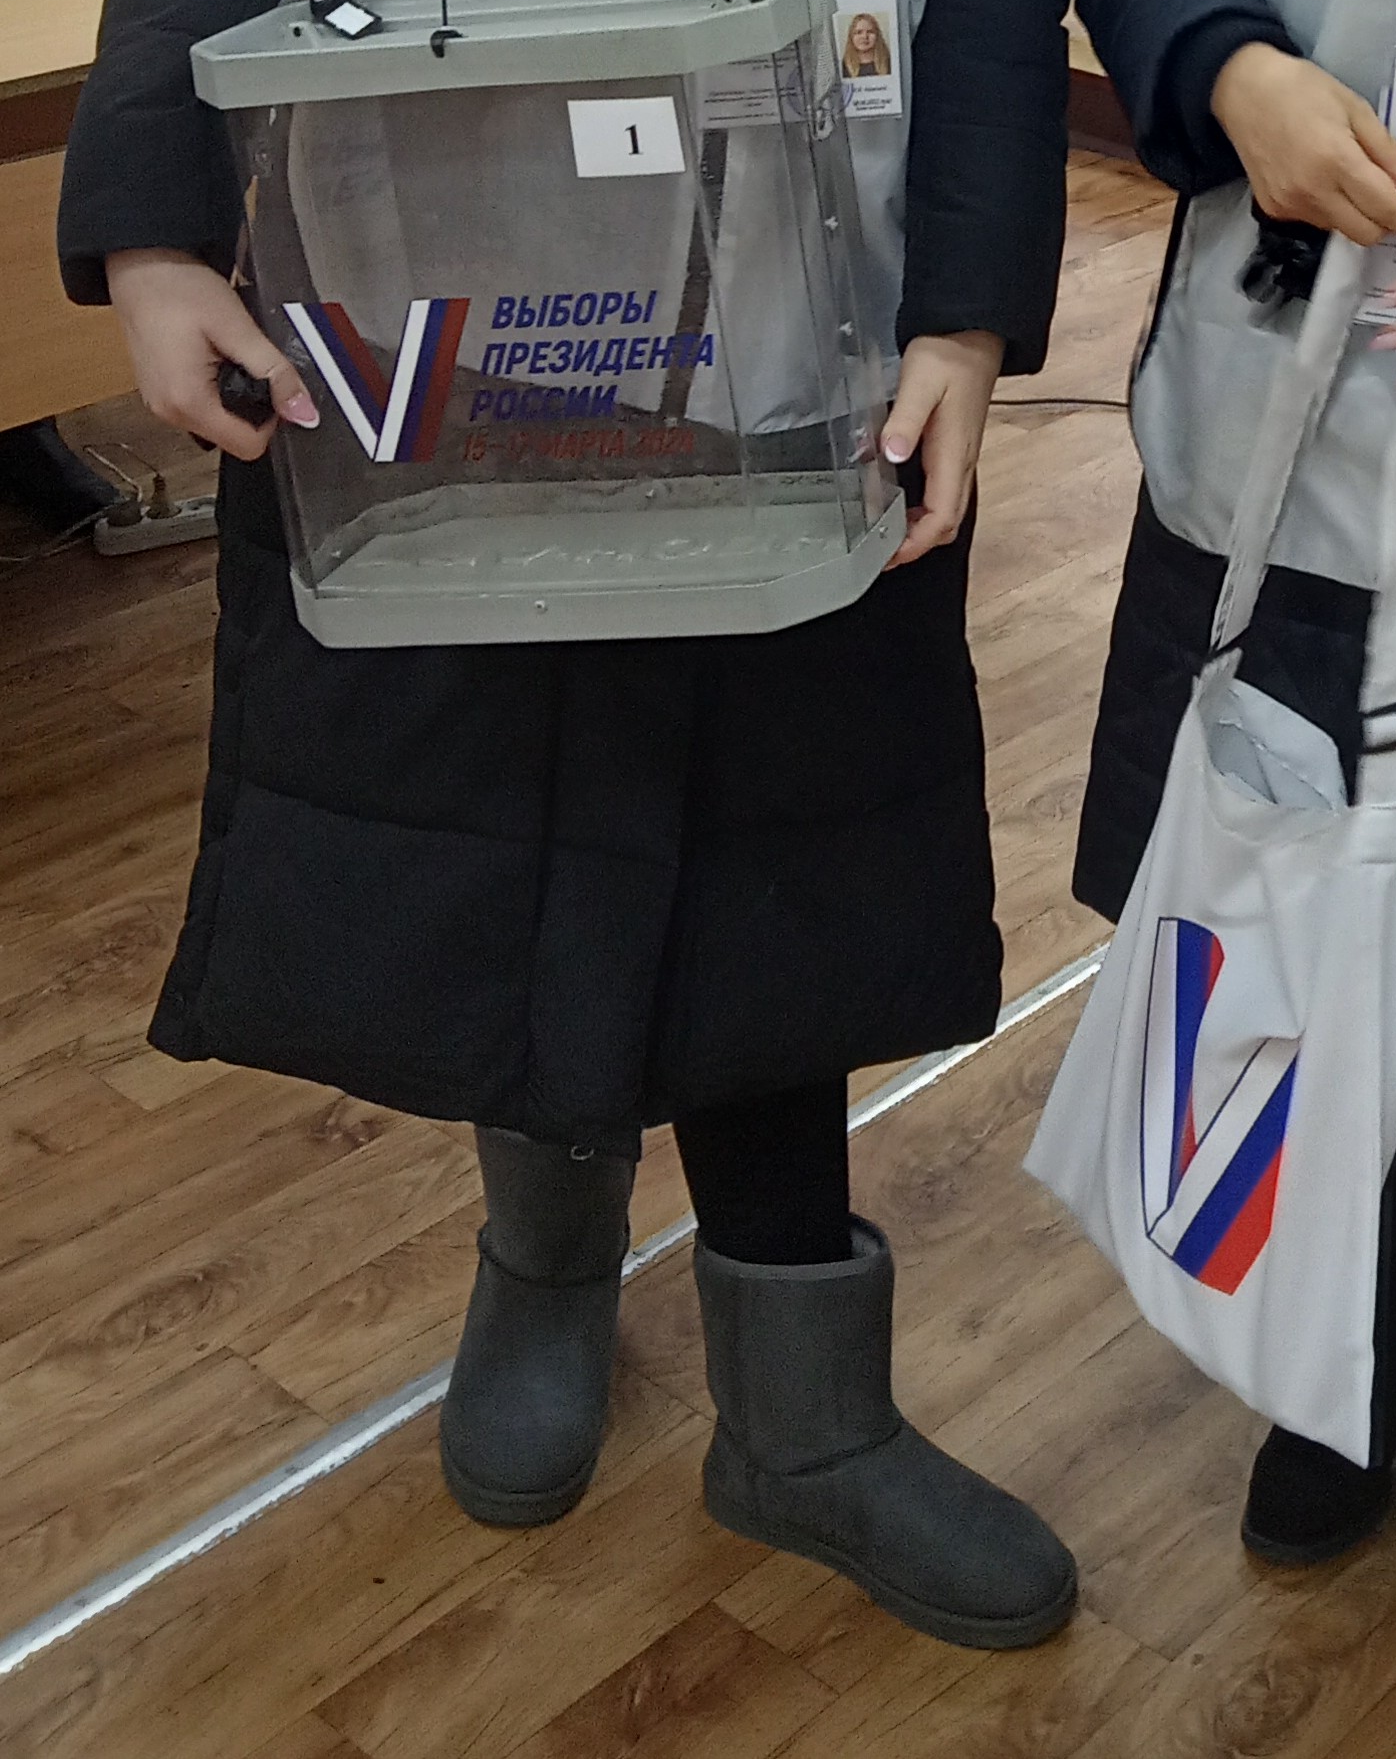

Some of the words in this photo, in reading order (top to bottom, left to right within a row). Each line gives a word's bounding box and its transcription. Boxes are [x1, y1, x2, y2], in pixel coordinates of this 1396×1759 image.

[625, 123, 643, 156] 1
[490, 289, 658, 331] ВЫБОРЫ
[480, 333, 715, 377] ПРЕЗИДЕНТА
[469, 384, 619, 422] РОССИИ
